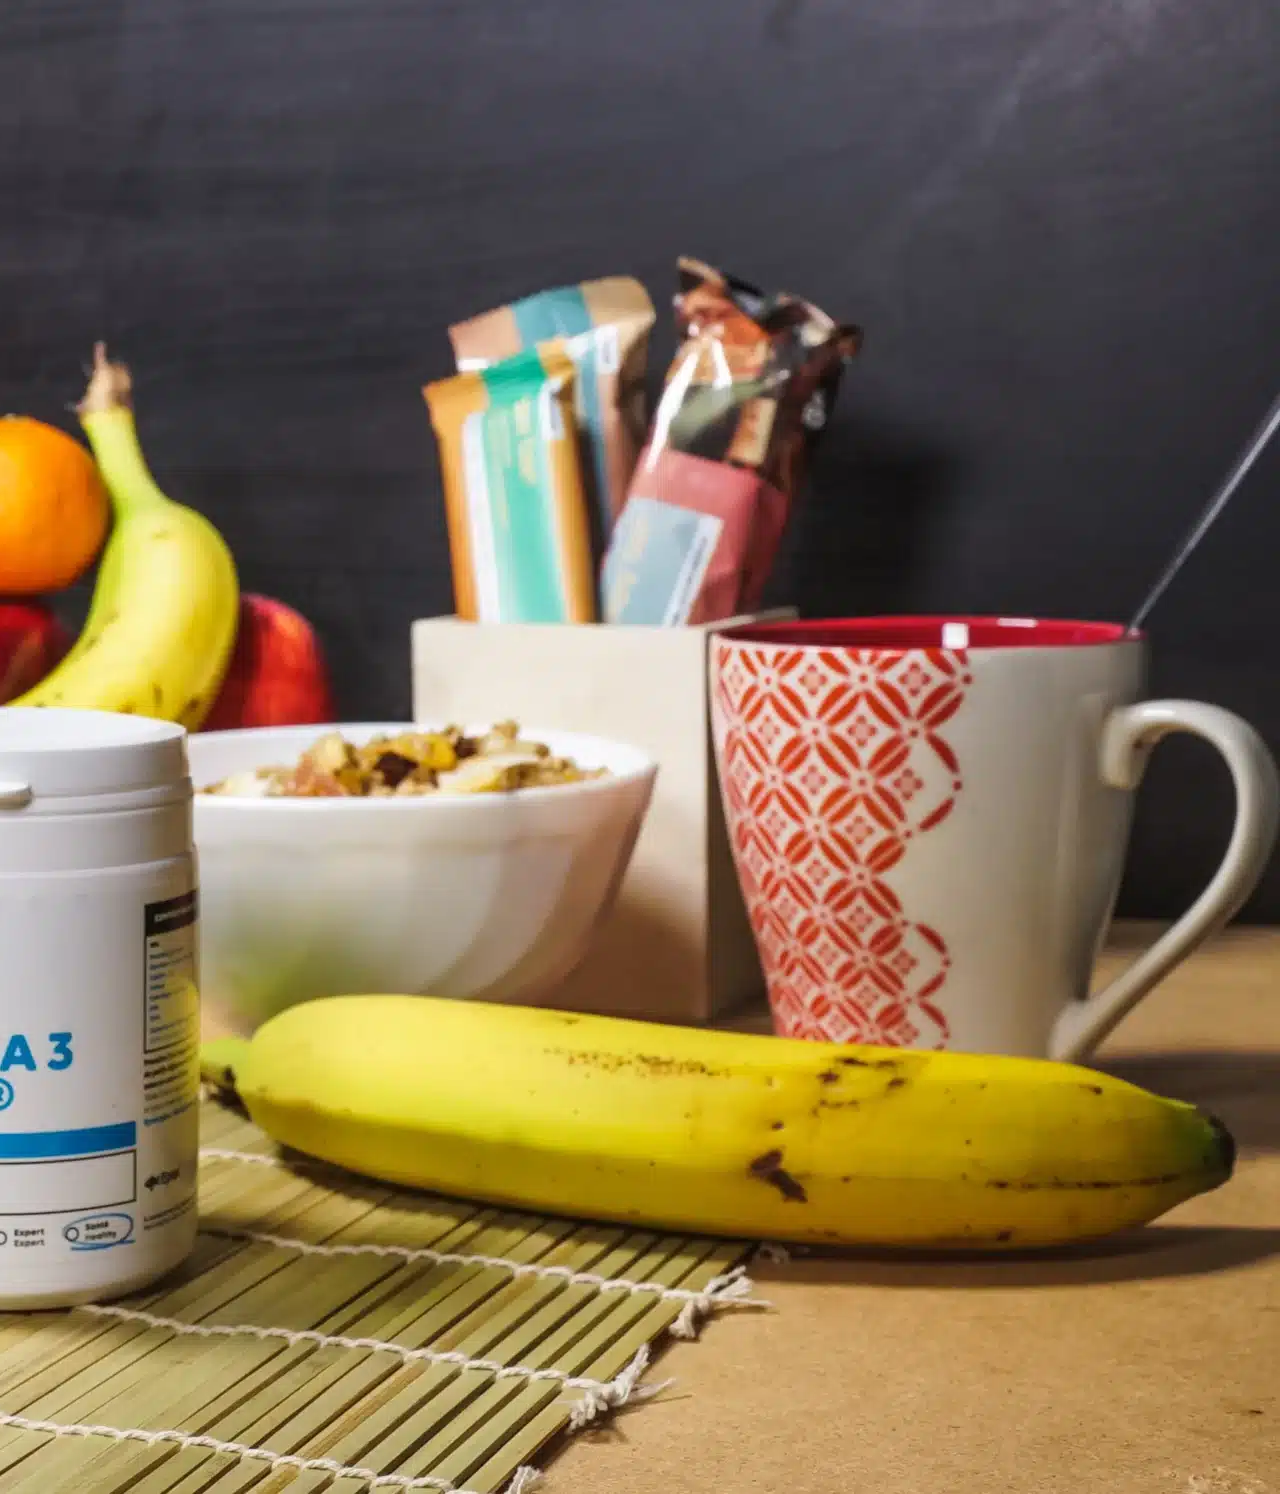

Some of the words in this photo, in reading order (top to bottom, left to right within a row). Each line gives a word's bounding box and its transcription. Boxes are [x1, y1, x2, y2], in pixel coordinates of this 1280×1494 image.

[47, 1031, 74, 1071] 3
[13, 1228, 45, 1238] Expert
[13, 1238, 45, 1248] Expert
